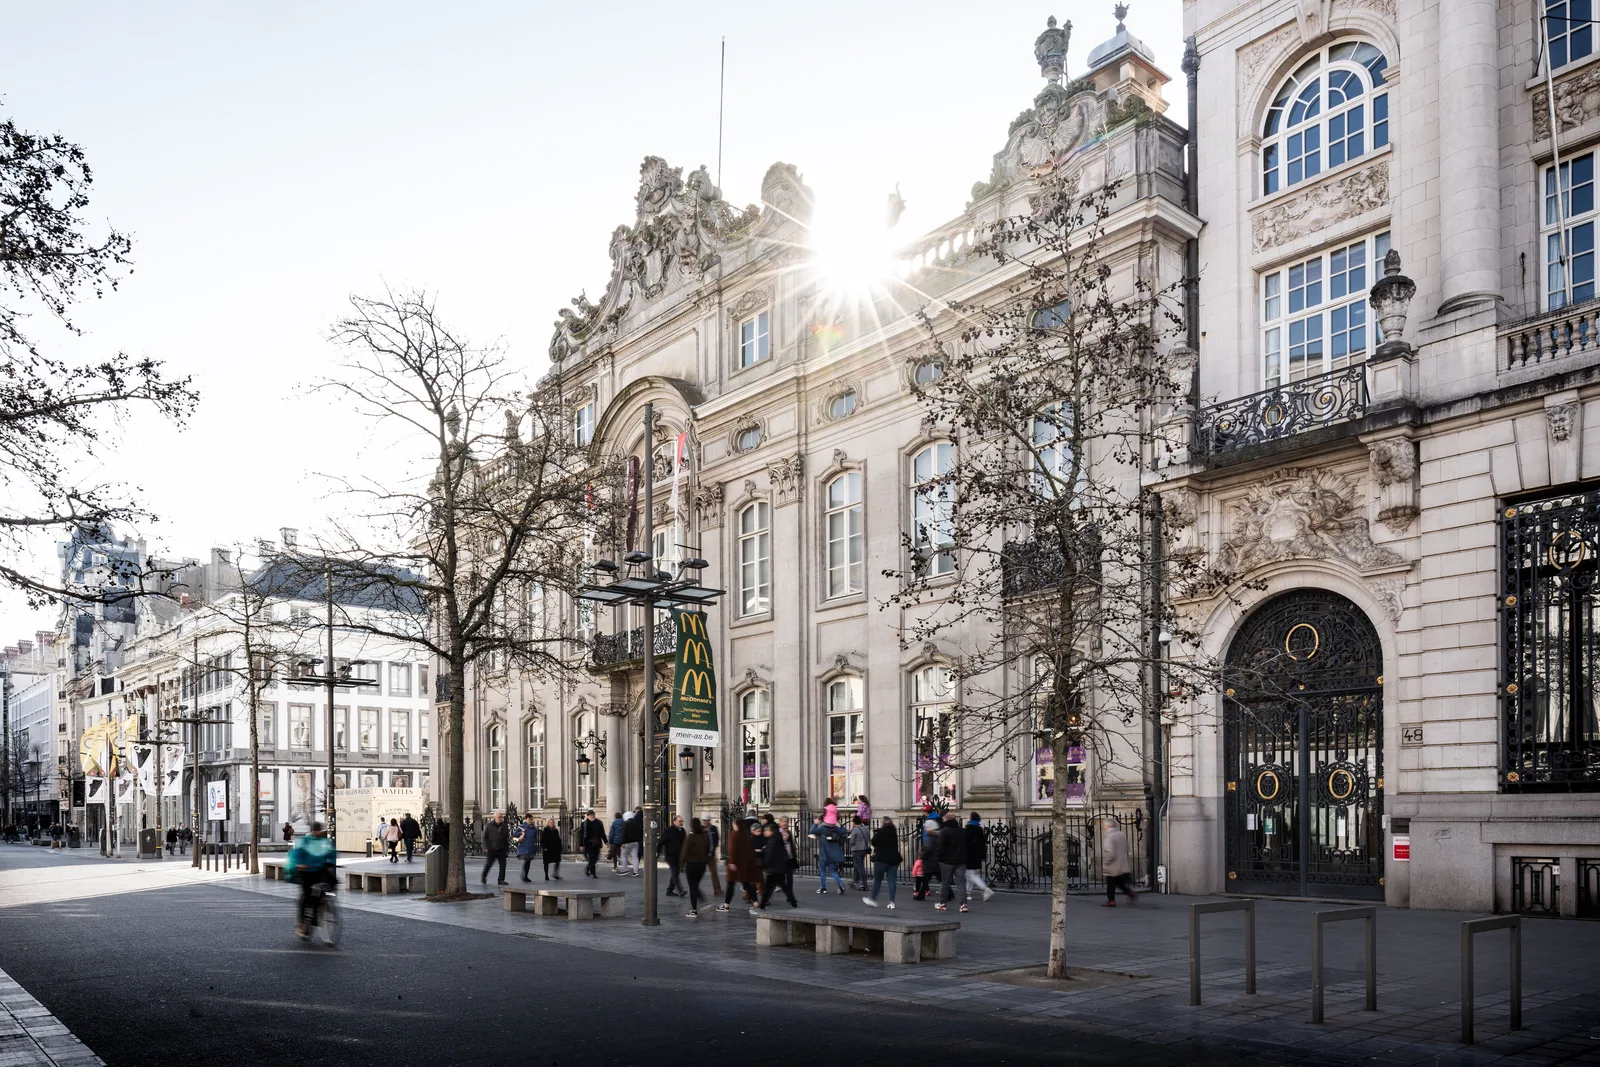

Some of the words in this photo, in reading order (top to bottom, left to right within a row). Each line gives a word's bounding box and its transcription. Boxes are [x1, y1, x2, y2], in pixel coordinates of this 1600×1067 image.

[680, 696, 712, 704] McDonald's
[675, 731, 714, 741] meir-as.be
[1404, 728, 1423, 741] 48
